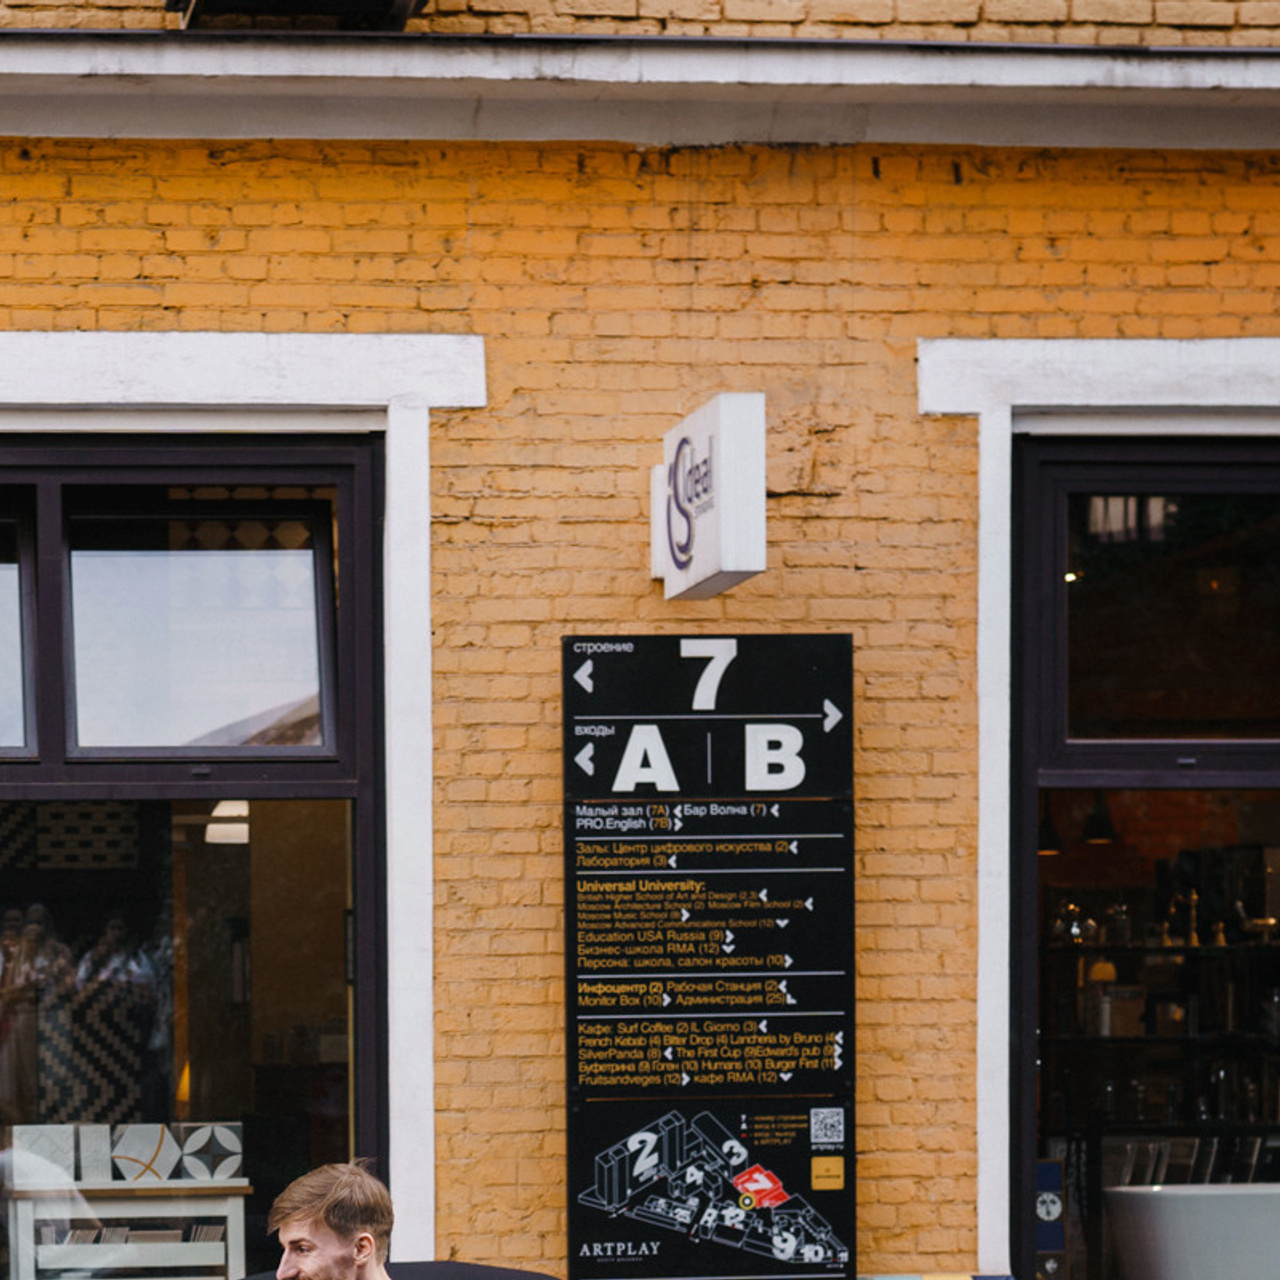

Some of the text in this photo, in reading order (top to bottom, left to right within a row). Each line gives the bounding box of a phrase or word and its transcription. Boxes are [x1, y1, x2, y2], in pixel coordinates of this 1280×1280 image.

[573, 642, 634, 654] строение
[679, 638, 738, 711] 7
[574, 725, 616, 737] входы
[575, 805, 618, 817] Малый
[620, 807, 644, 817] зал
[683, 803, 708, 817] Бар
[709, 804, 748, 816] Волна
[750, 803, 767, 817] (7)
[575, 818, 647, 831] PRO.English
[612, 842, 648, 855] Центр
[650, 843, 713, 854] цифрового
[715, 842, 772, 855] искусства
[774, 841, 789, 854] (2)
[575, 855, 651, 868] Лаборатория
[577, 880, 706, 894] Universal University:
[577, 930, 724, 942] Education USA Russia (9)
[577, 943, 720, 955] Бизнес-школа RMA (12)
[677, 957, 713, 967] салон
[715, 956, 764, 968] красоты
[766, 955, 785, 968] (10)
[577, 980, 778, 995] Инфоцентр (2) Рабочая Станция (2)
[577, 995, 617, 1006] Monitor
[619, 995, 640, 1006] Box
[675, 994, 763, 1006] Администрация
[617, 1022, 639, 1034] Surf
[640, 1022, 674, 1033] Coffee
[779, 1033, 792, 1046] by
[675, 1047, 696, 1058] The
[720, 1045, 742, 1059] Cup
[801, 1046, 821, 1059] pub
[726, 1072, 755, 1082] RMA
[757, 1071, 778, 1084] (12)
[627, 1131, 659, 1177] 2
[722, 1139, 748, 1166] 3
[685, 1165, 704, 1185] 4
[579, 1241, 661, 1257] ARTPLAY
[772, 1231, 797, 1261] 9
[800, 1243, 825, 1263] 10
